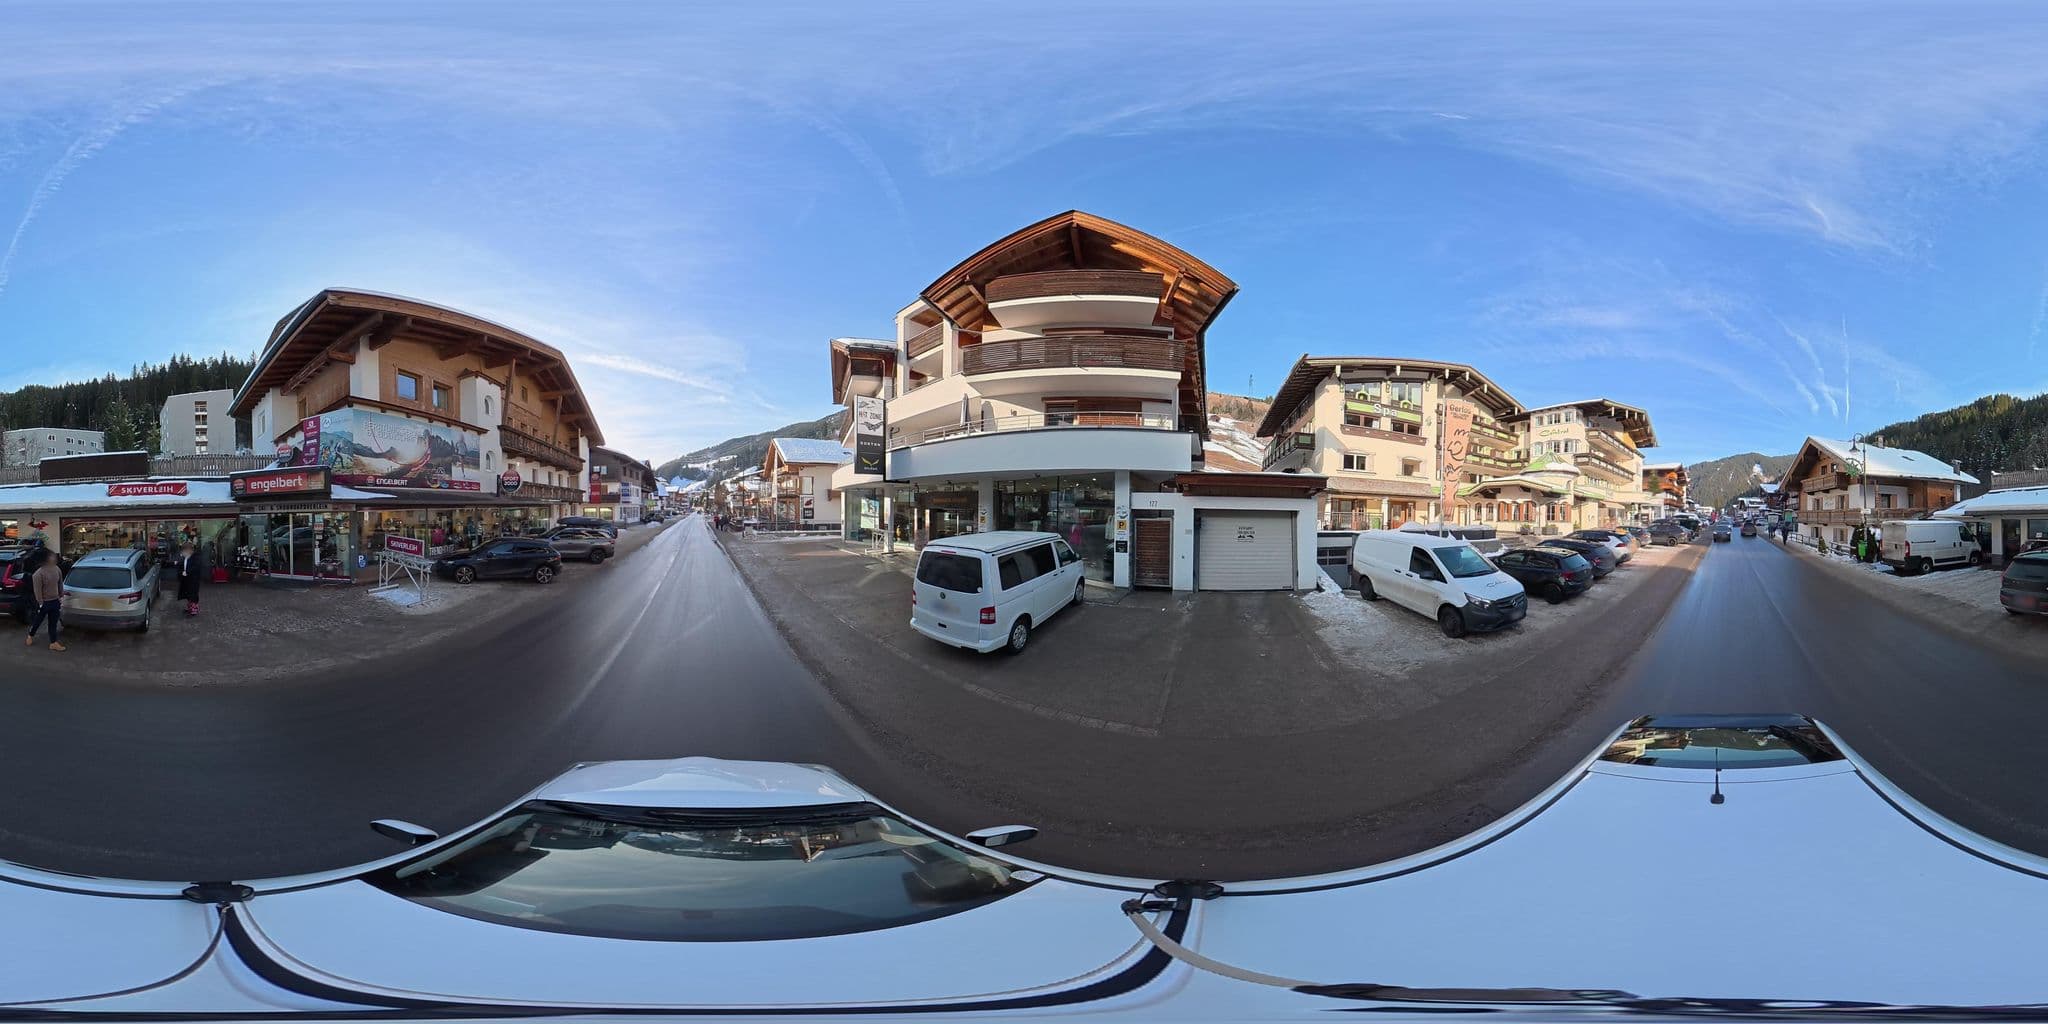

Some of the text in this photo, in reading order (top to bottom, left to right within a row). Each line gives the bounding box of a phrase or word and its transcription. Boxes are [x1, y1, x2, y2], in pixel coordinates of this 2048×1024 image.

[1374, 403, 1398, 417] Spa
[121, 485, 174, 494] SKIVERLEIH
[250, 475, 303, 492] engelbert
[390, 540, 418, 552] SKIVERLEIH
